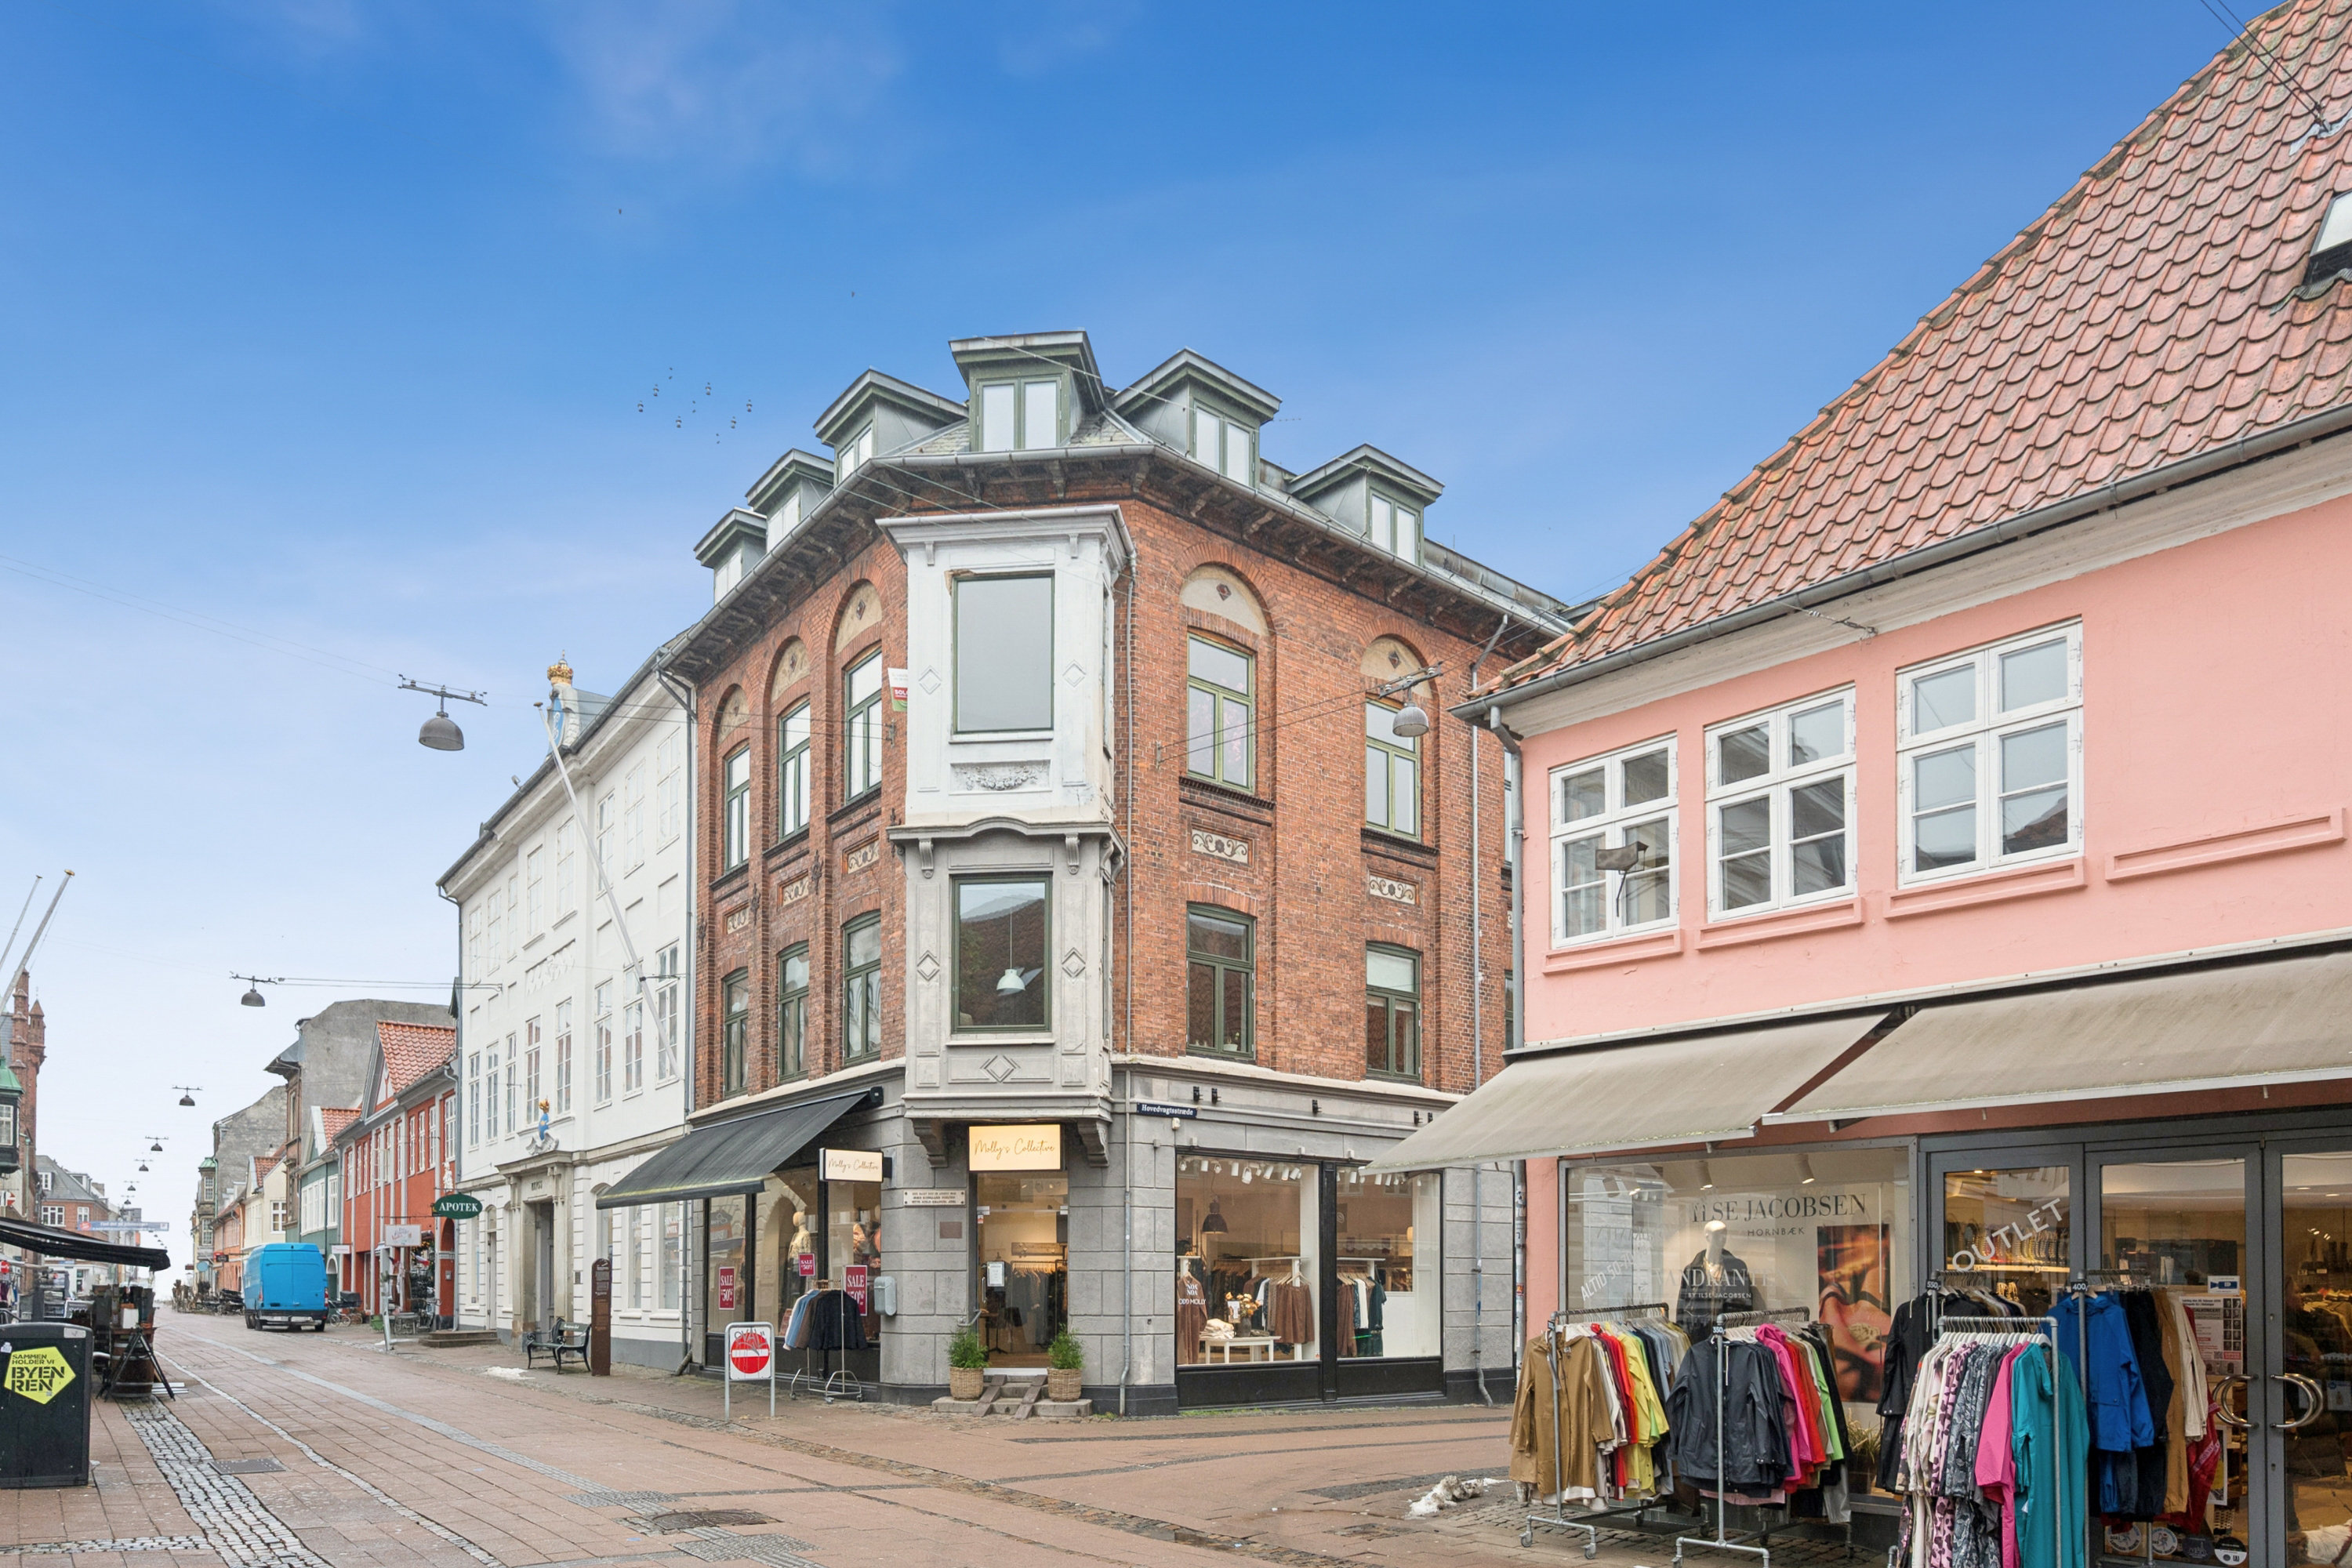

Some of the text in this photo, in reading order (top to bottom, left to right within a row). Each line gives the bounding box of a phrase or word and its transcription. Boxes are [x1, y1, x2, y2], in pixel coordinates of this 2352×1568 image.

[1142, 1104, 1194, 1116] Hovedvagtsstræde
[974, 1138, 1055, 1161] Molly's Collective
[439, 1202, 478, 1212] APOTEK
[1744, 1193, 1867, 1222] JACOBSEN
[1748, 1226, 1805, 1237] HORNBÆK
[1952, 1198, 2062, 1272] OUTLET
[720, 1275, 734, 1287] SALE
[847, 1275, 865, 1287] SALE
[1581, 1272, 1607, 1301] ALTID
[12, 1366, 65, 1379] BYEN
[11, 1379, 53, 1392] REN
